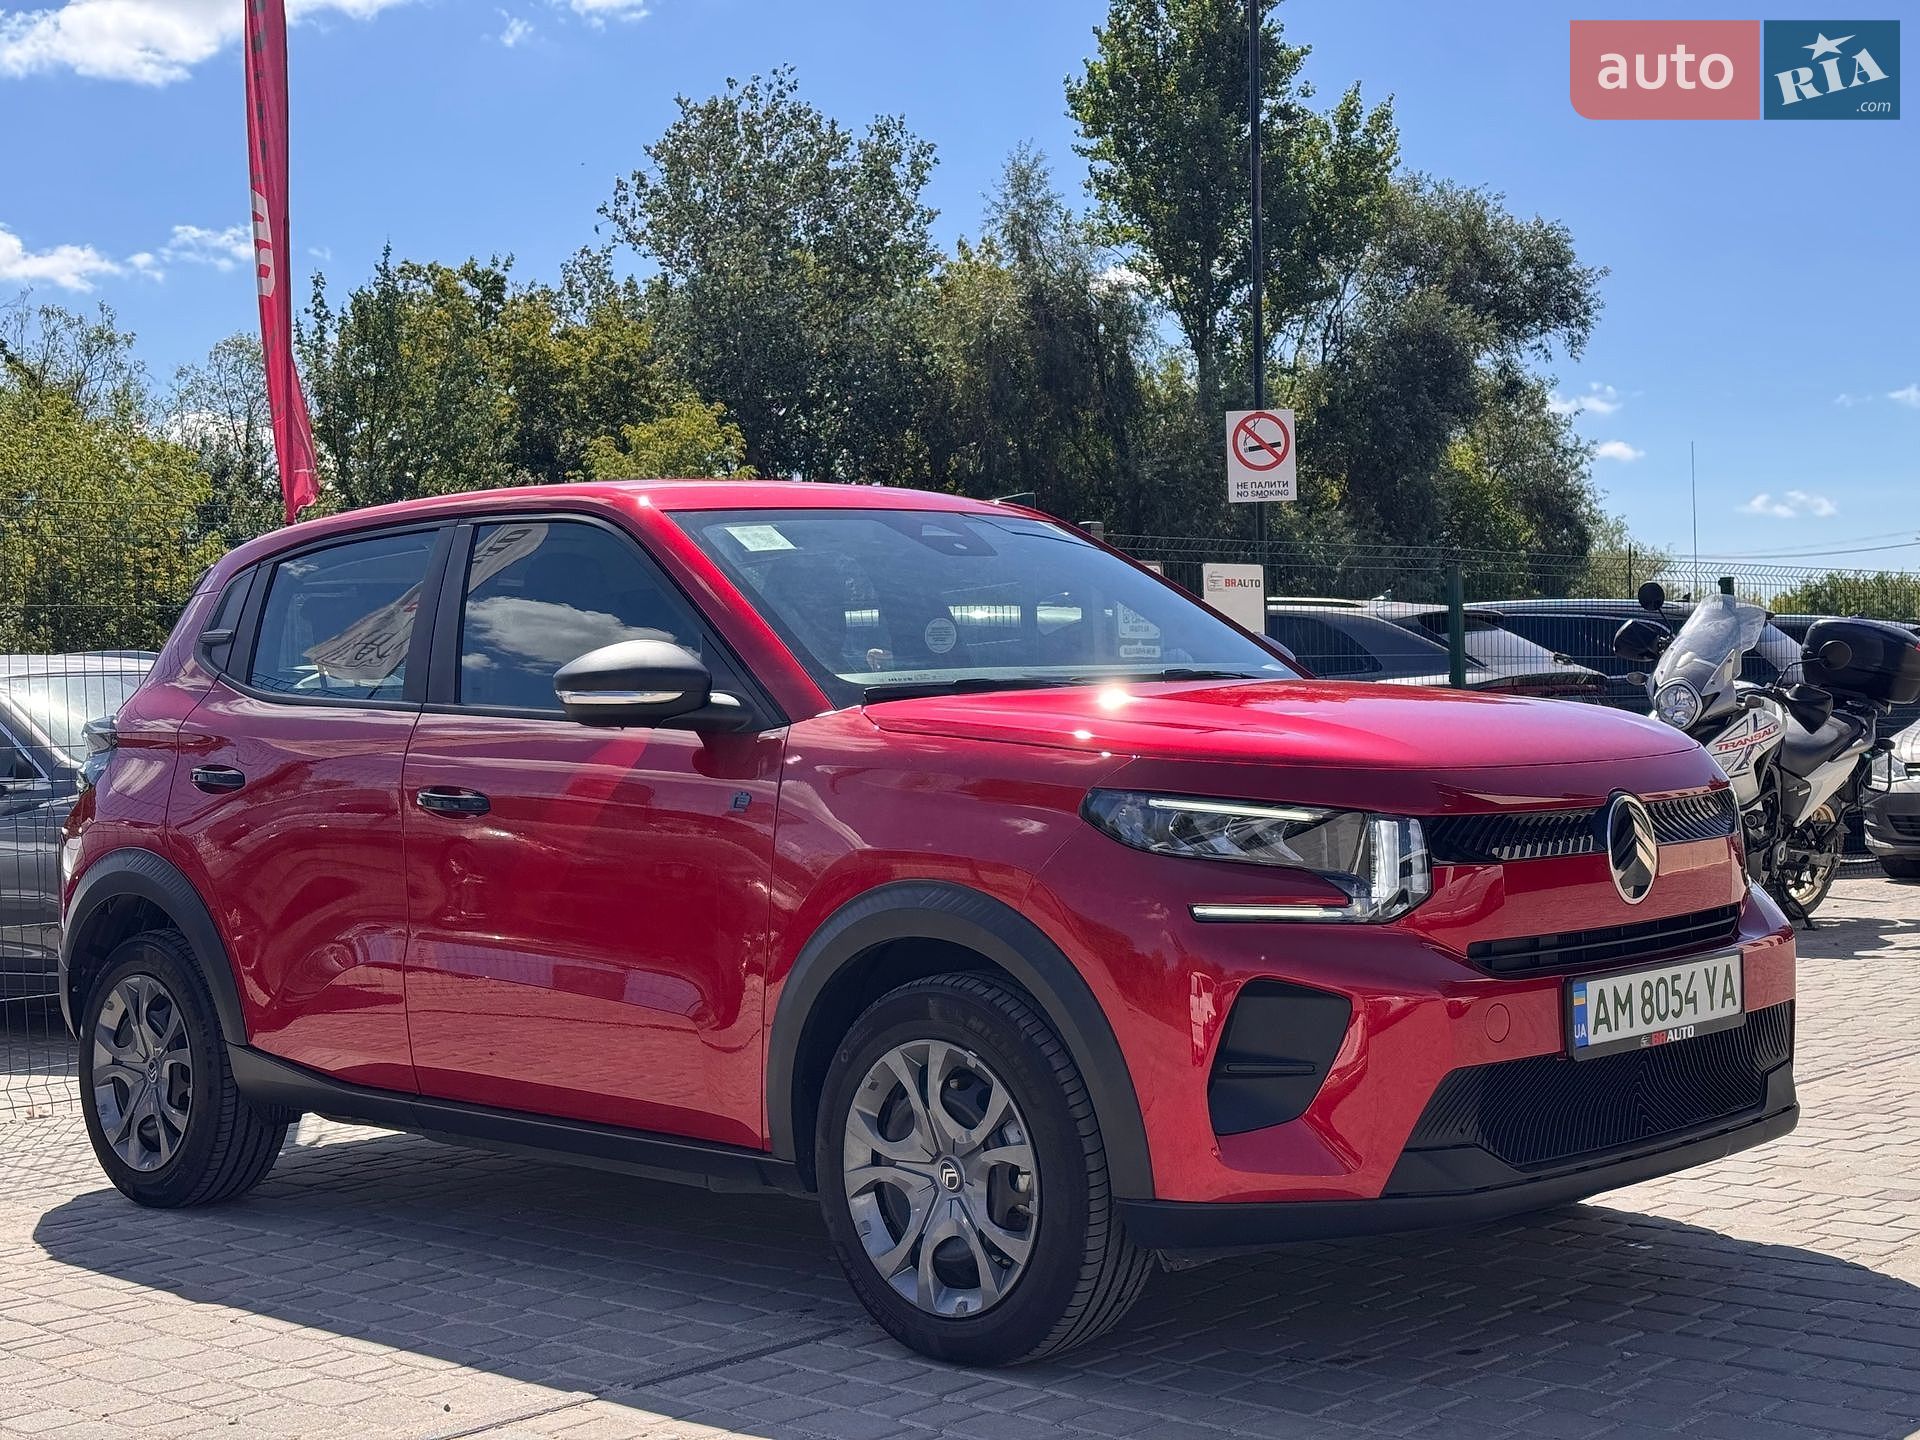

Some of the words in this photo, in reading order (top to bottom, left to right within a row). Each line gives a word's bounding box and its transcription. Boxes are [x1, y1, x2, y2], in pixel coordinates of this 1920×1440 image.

[1236, 482, 1249, 490] НЕ
[1250, 480, 1289, 489] ПАЛИТИ
[1236, 490, 1249, 498] NO
[1250, 489, 1290, 498] SMOKING
[1224, 578, 1261, 588] BRAUTO
[1715, 724, 1779, 751] TRANSALP
[1592, 982, 1634, 1035] AM
[1640, 970, 1698, 1025] 8054
[1704, 963, 1737, 1011] YA
[1574, 1023, 1587, 1039] UA
